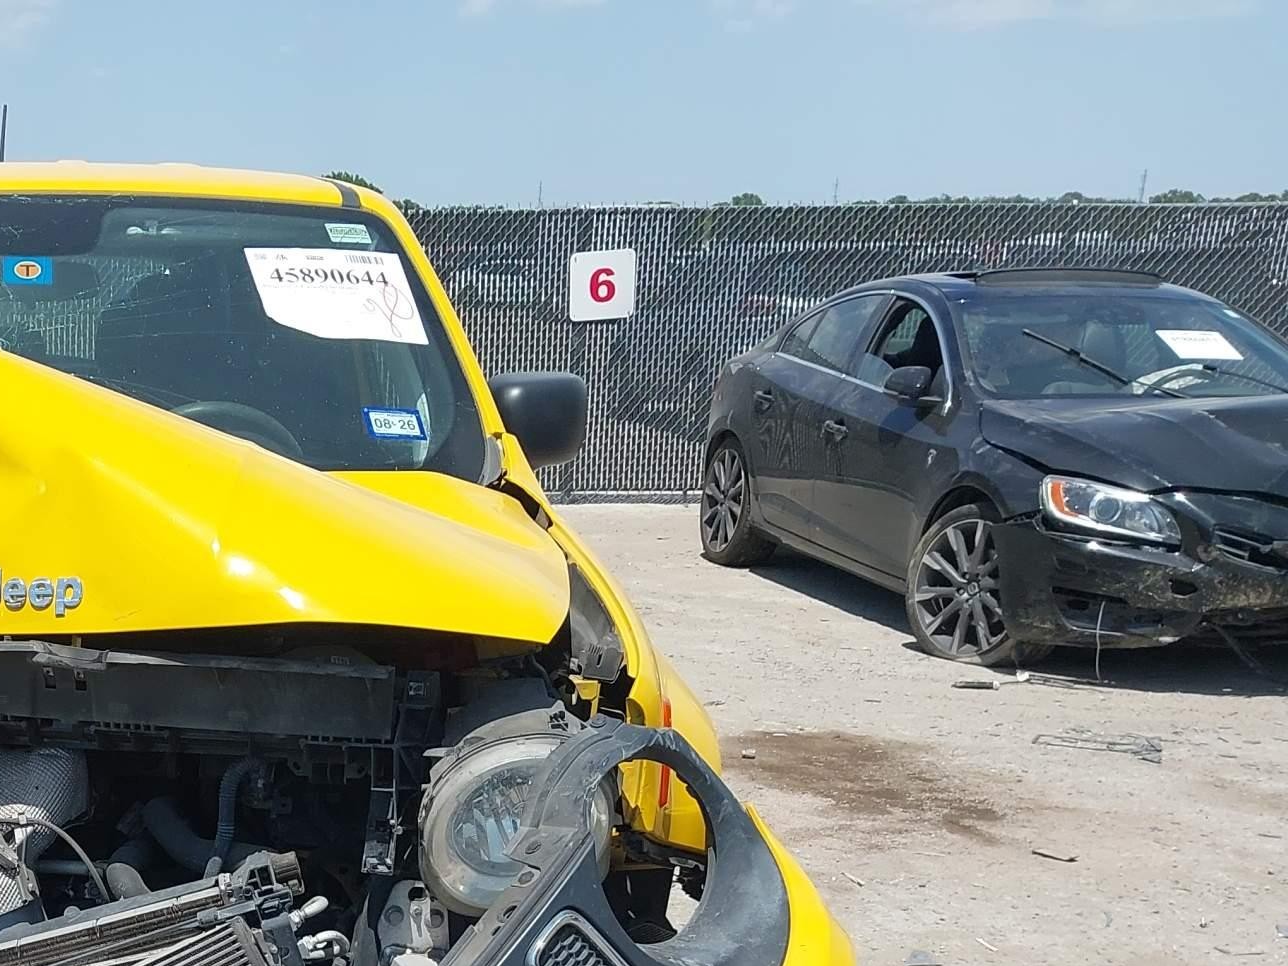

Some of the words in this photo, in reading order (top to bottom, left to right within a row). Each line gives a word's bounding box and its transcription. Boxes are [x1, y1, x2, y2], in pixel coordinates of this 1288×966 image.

[270, 268, 389, 286] 45890644
[589, 268, 616, 303] 6
[374, 418, 392, 429] 08
[398, 419, 416, 431] 26
